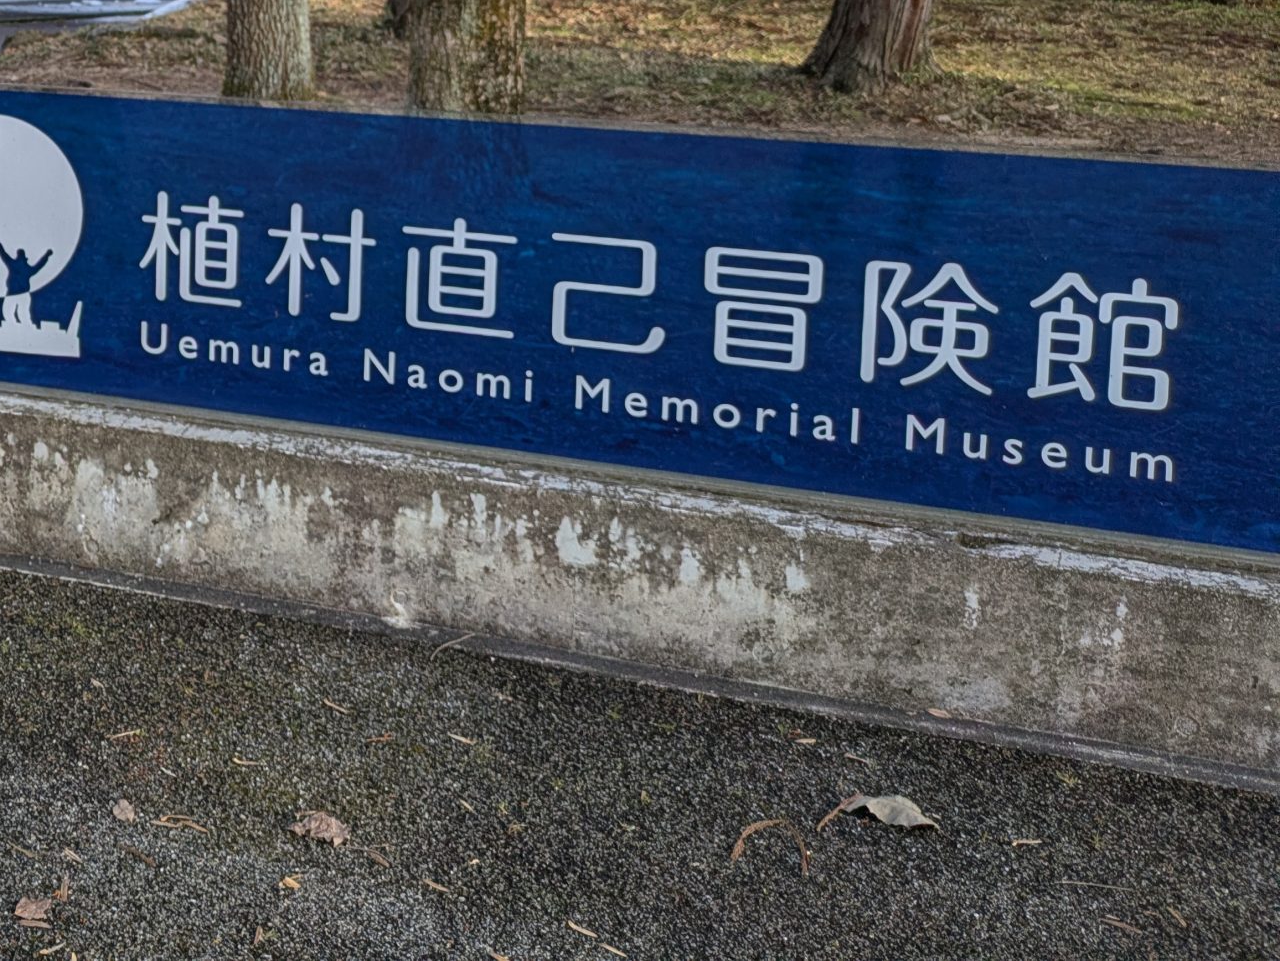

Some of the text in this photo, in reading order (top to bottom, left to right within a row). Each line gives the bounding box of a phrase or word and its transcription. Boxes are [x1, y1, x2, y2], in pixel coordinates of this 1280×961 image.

[139, 190, 1179, 411] 植村直己冒険館
[140, 320, 1173, 482] Uemura Naomi Memorial Museum
